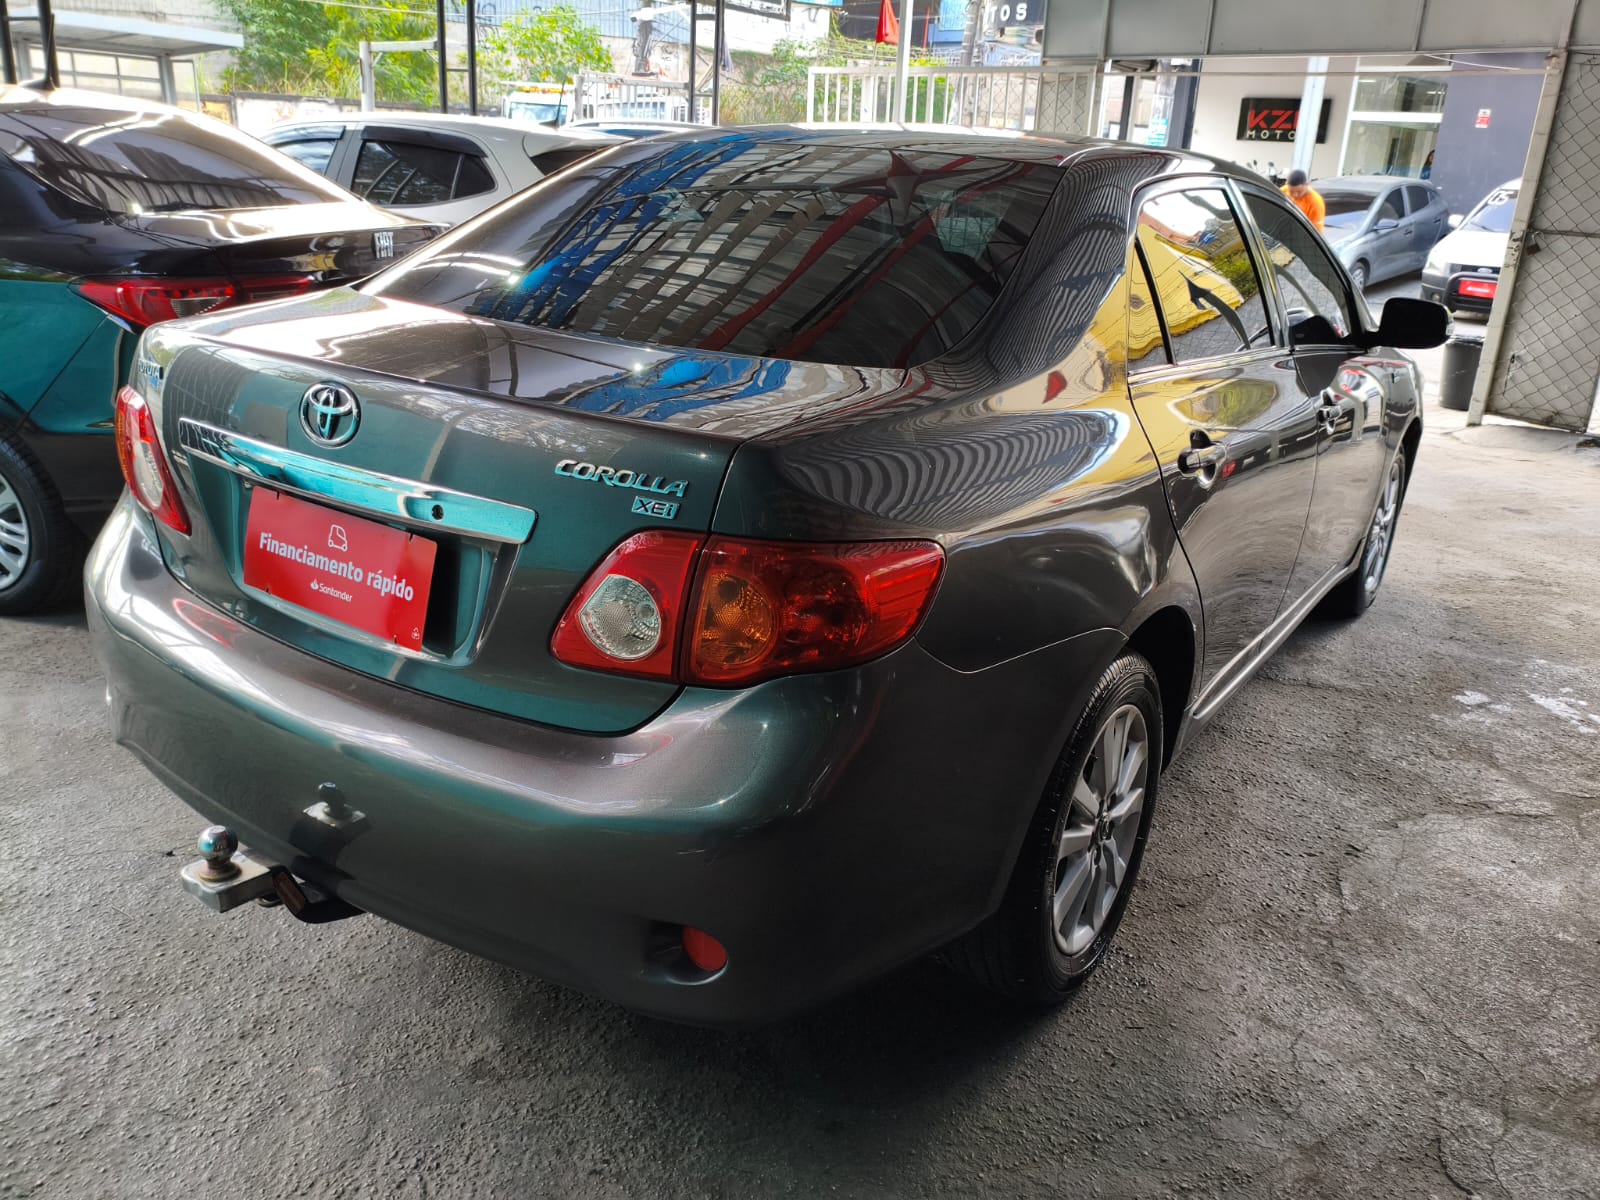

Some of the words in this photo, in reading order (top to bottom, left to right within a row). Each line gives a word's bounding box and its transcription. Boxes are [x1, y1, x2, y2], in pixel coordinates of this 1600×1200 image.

[374, 231, 393, 258] FIAT
[554, 459, 689, 498] COROLLA
[259, 531, 364, 583] Financiamento
[366, 569, 414, 602] rápido
[318, 583, 353, 602] Santander
